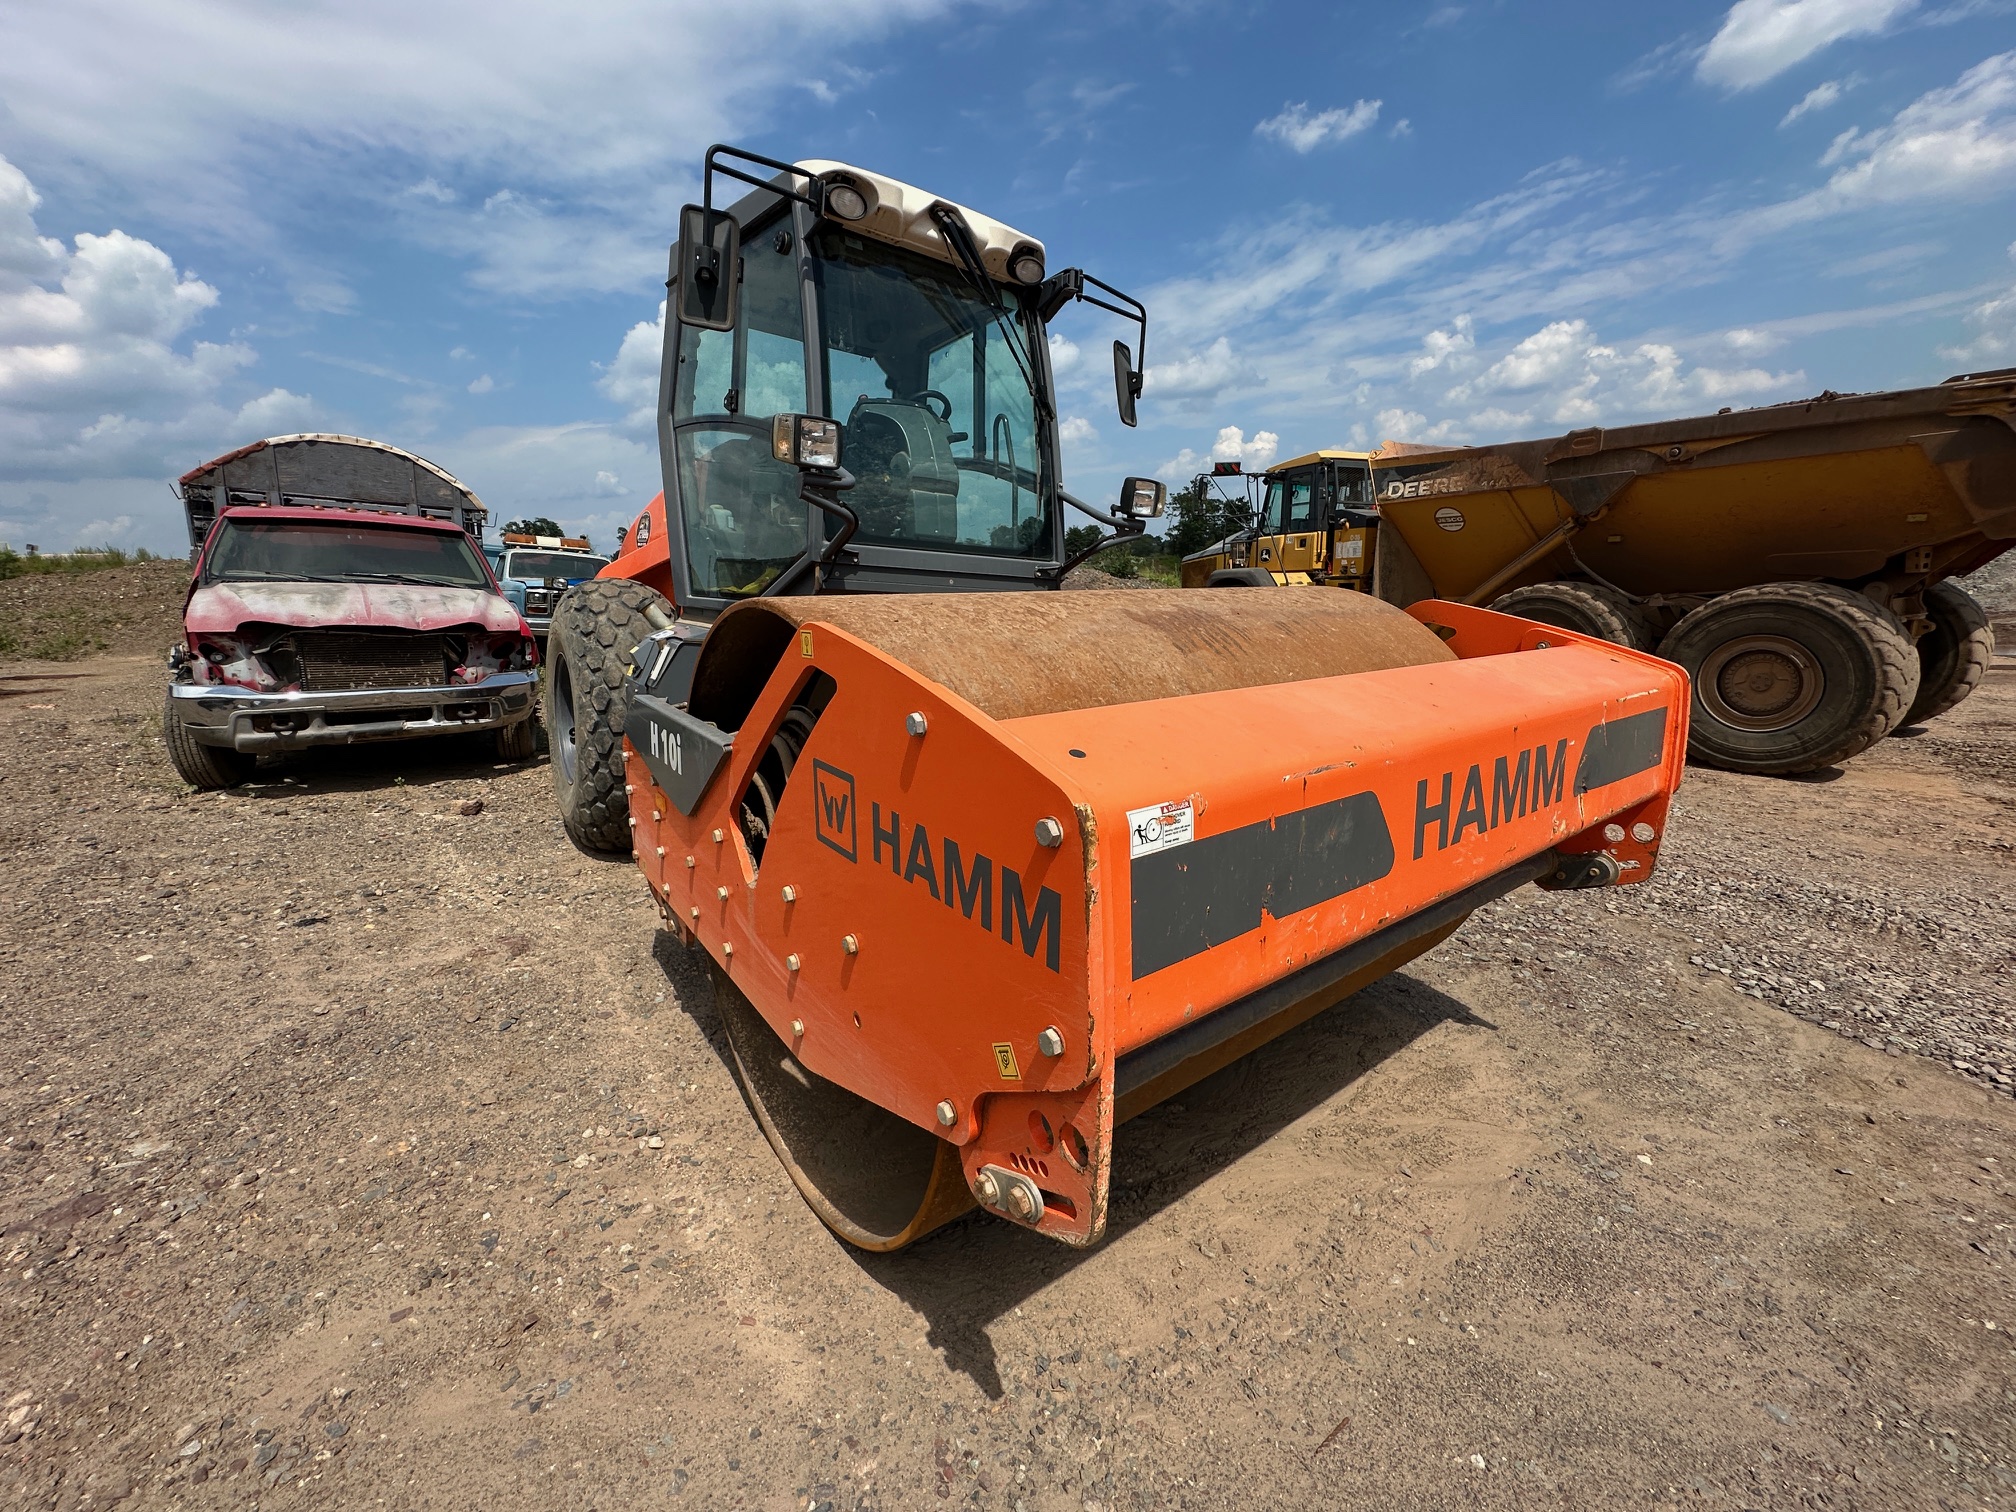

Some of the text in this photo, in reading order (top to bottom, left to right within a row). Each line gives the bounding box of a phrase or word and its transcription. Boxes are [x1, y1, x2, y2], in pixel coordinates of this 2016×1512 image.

[1387, 476, 1464, 500] DEERE
[650, 720, 682, 775] H 10i
[1413, 738, 1567, 861] HAMM
[872, 801, 1061, 974] HAMM
